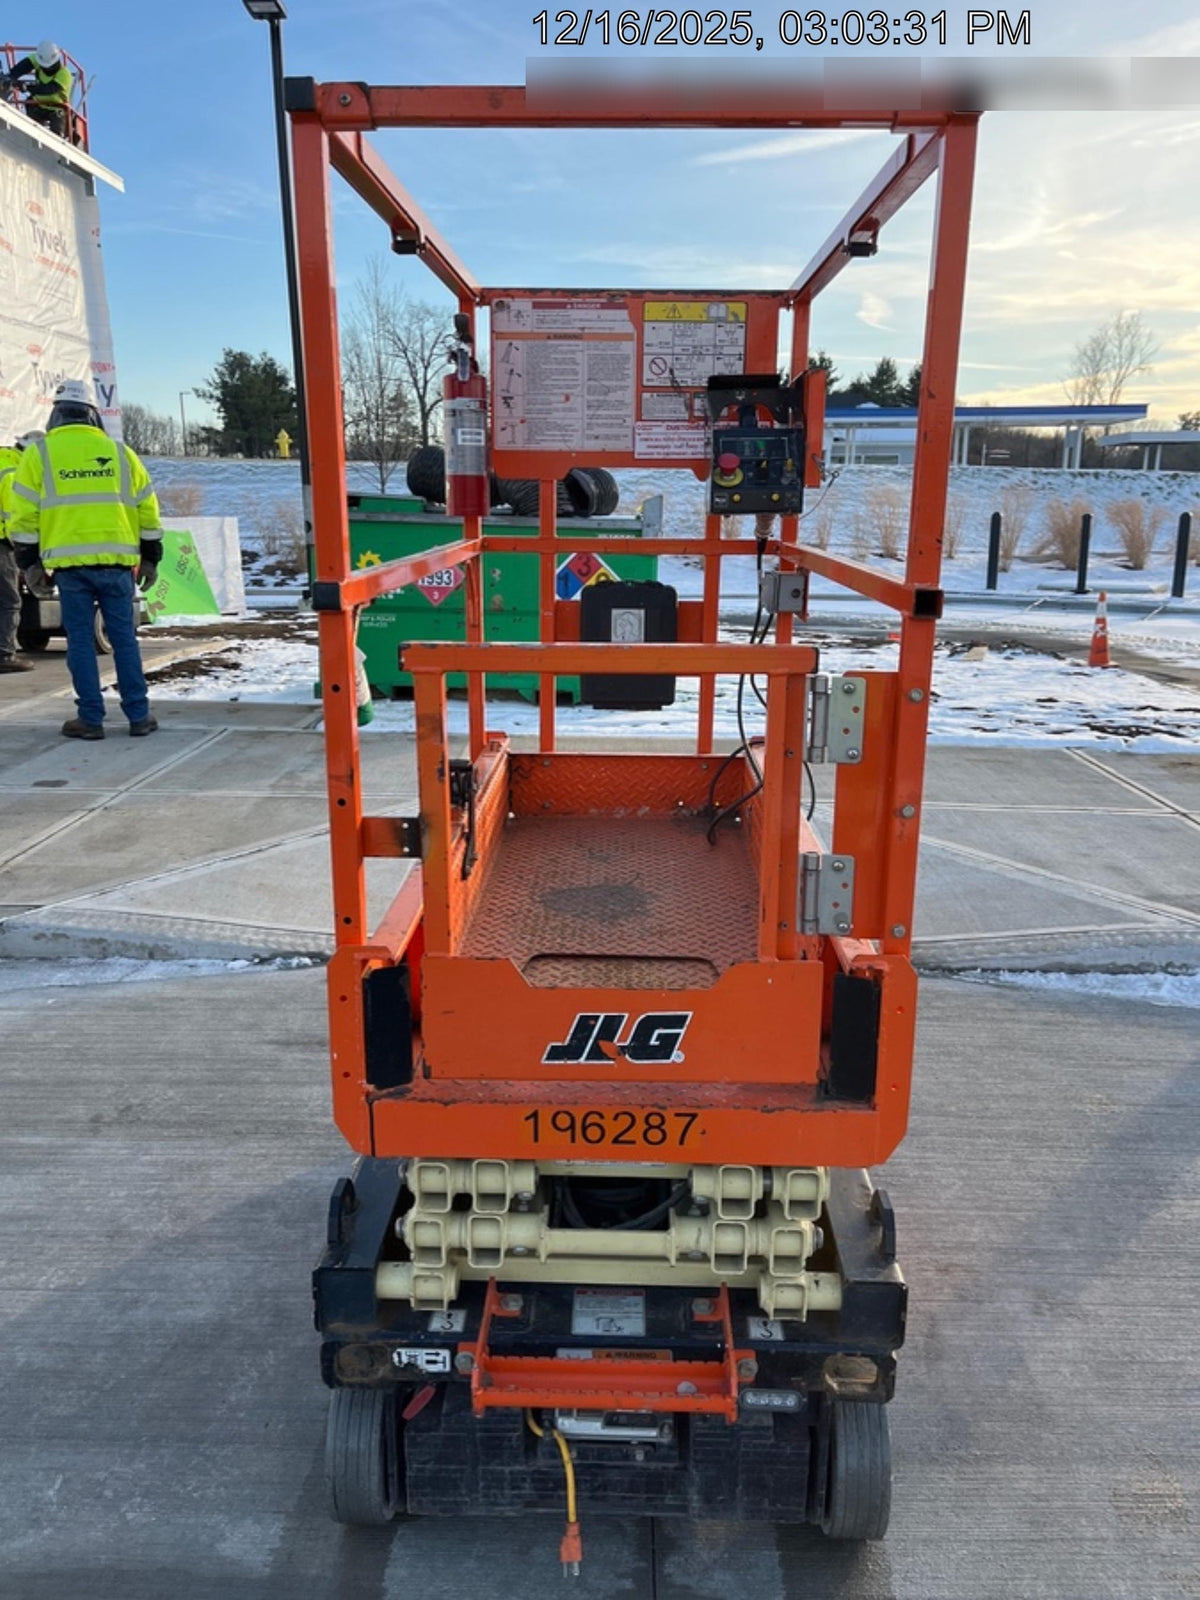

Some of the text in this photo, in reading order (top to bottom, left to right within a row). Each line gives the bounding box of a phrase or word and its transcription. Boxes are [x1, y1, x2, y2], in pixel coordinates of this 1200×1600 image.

[28, 217, 68, 256] Tyvek
[59, 468, 115, 480] Schimenti
[541, 1011, 693, 1065] JLG
[524, 1109, 699, 1146] 196287
